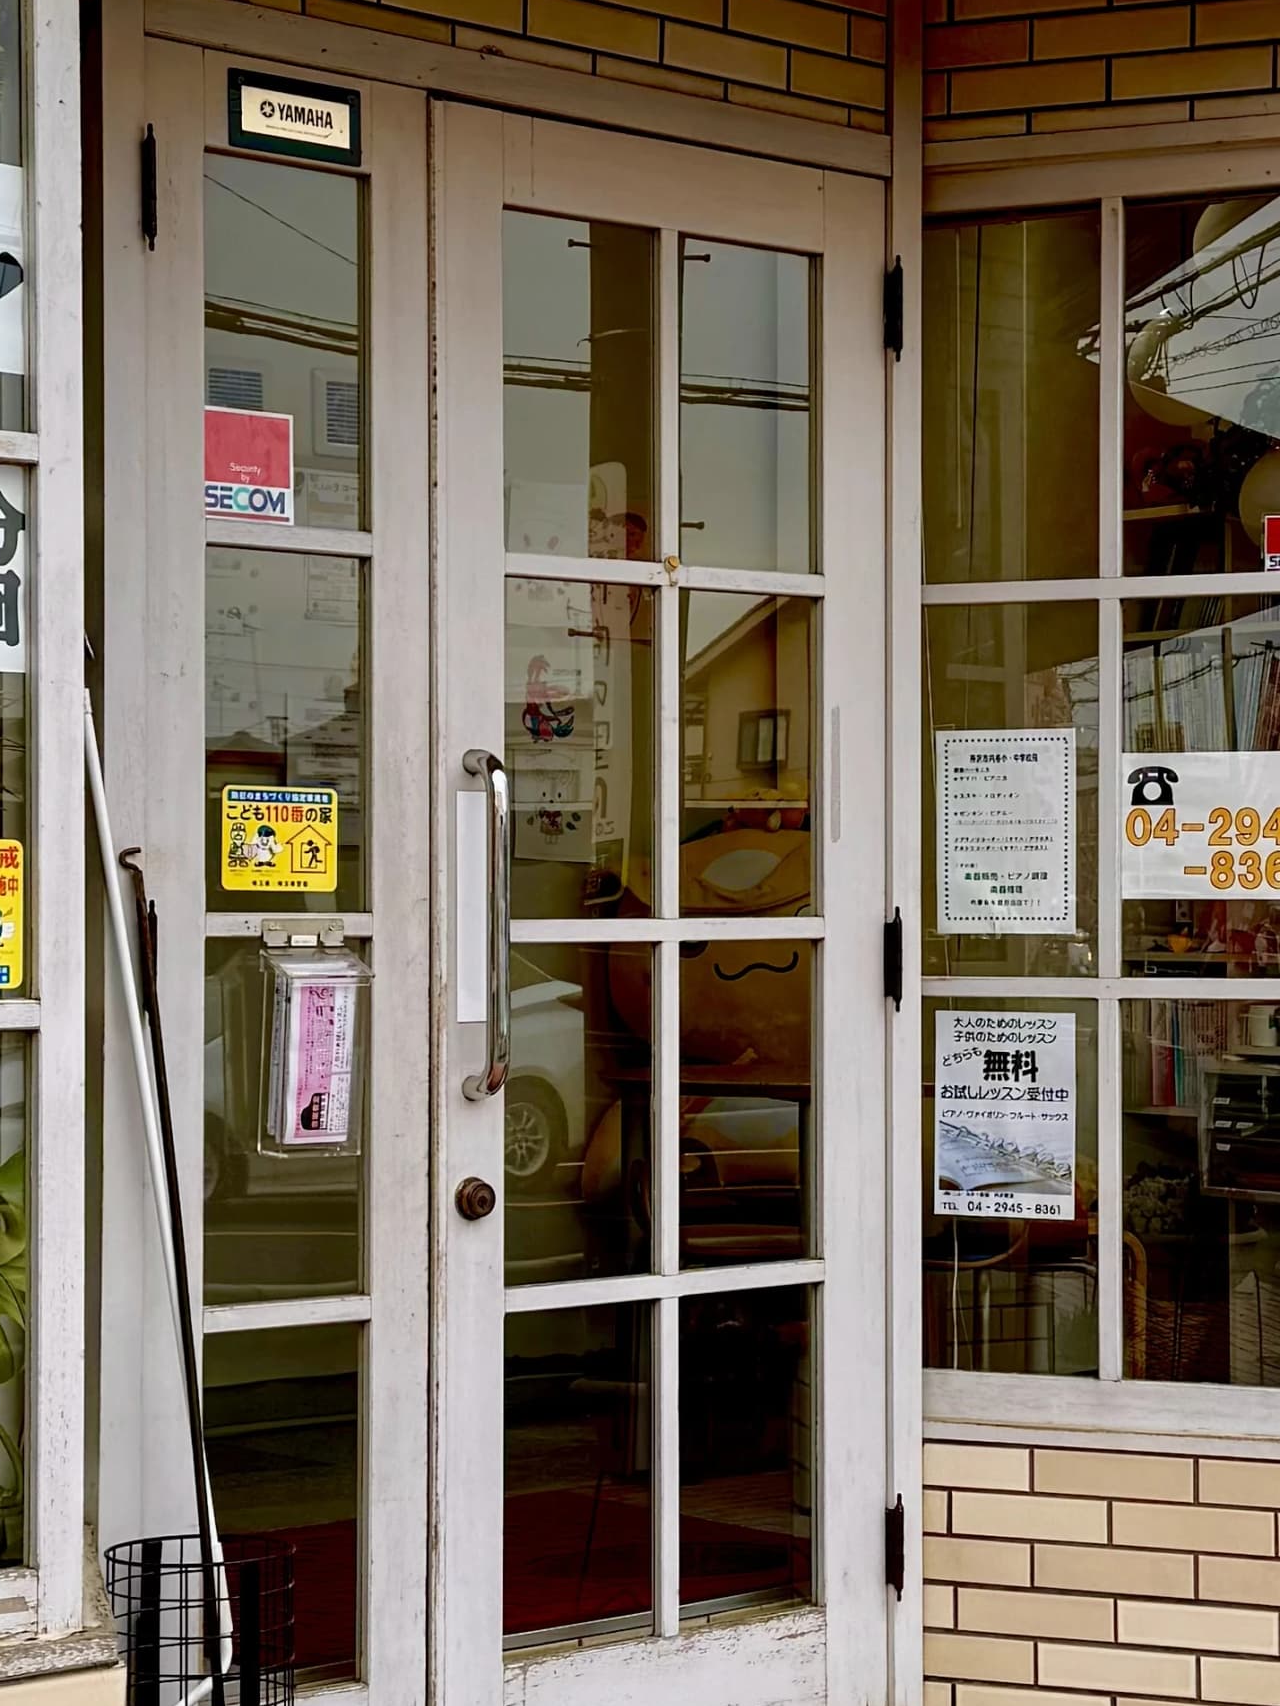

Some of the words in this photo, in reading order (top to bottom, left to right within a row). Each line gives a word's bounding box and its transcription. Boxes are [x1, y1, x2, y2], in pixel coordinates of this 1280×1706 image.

[276, 102, 334, 130] YAMAHA
[228, 461, 262, 476] Security
[204, 484, 286, 515] SECOM
[226, 803, 333, 825] こども110番の家
[953, 1016, 1058, 1030] 大人のためのレッスン
[953, 1030, 1058, 1045] 子供のためのレッスン
[941, 1046, 984, 1068] どちらも
[982, 1048, 1040, 1084] 無料
[940, 1084, 1070, 1102] お試しレッスン受付中
